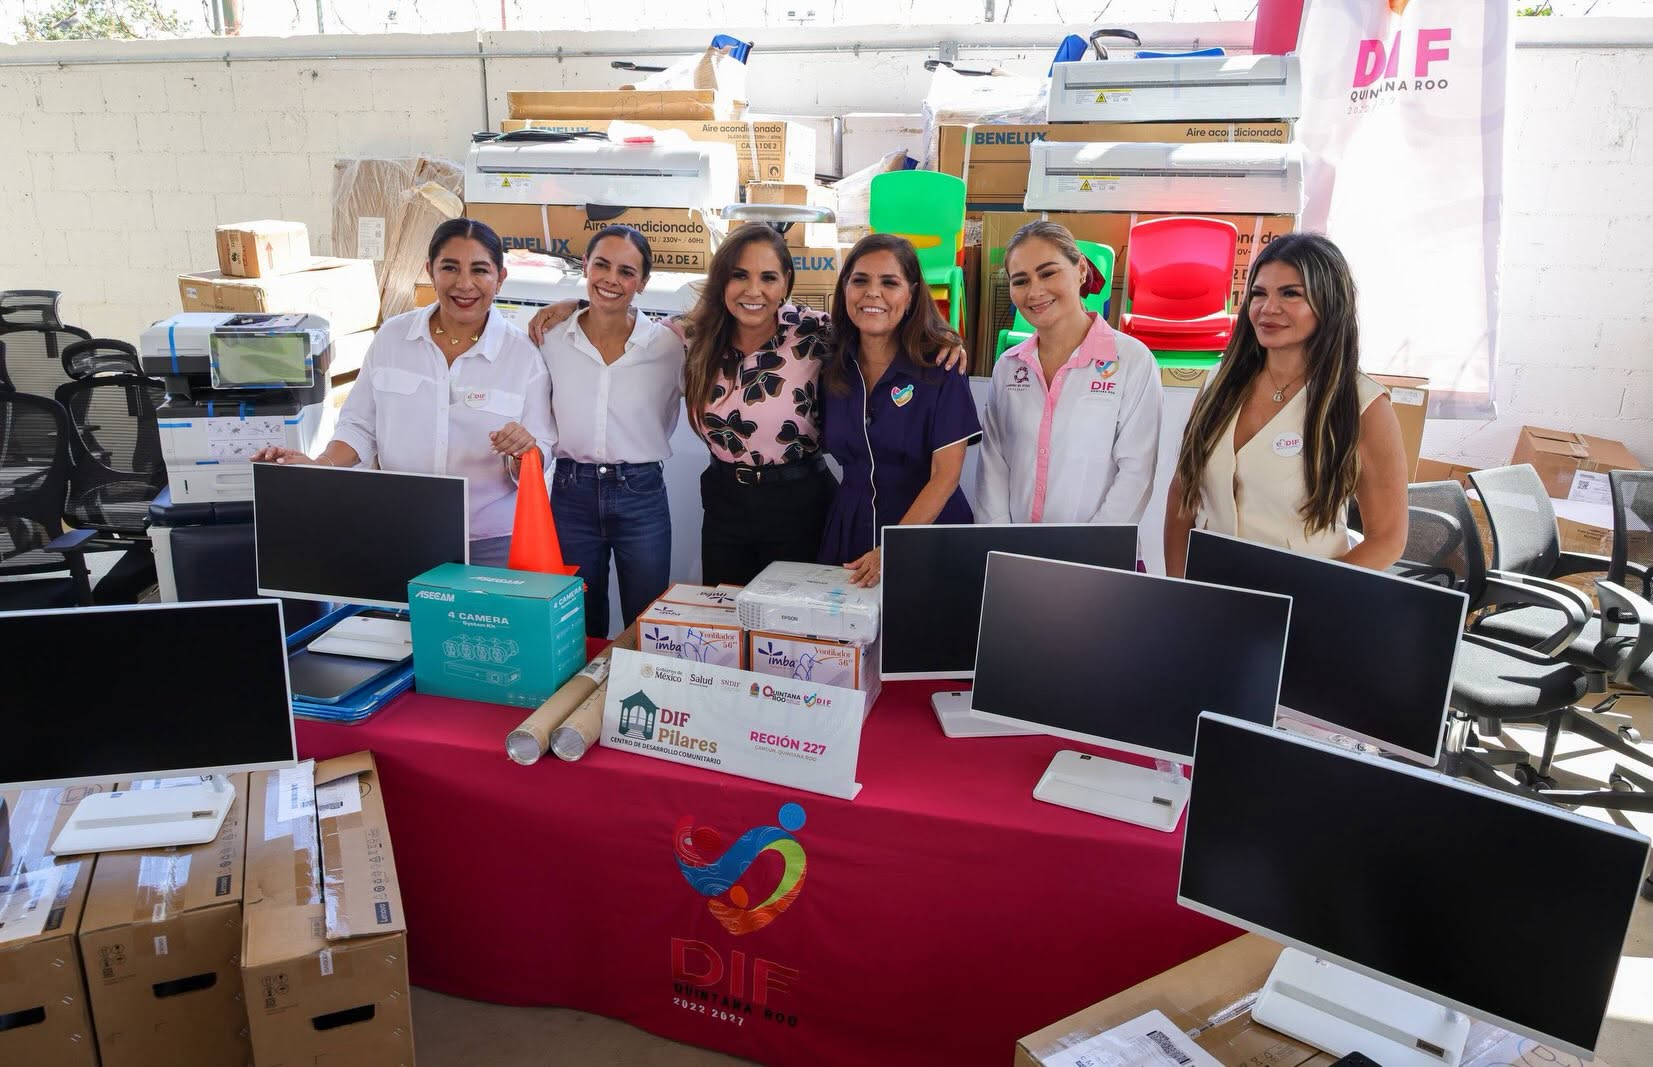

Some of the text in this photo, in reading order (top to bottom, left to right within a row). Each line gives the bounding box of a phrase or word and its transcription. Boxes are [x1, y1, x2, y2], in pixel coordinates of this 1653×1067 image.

[1353, 28, 1452, 88] DIF
[1415, 79, 1448, 91] ROO
[702, 124, 782, 133] Aire acondionado
[1186, 128, 1206, 137] Aire
[975, 132, 1048, 144] BENELUX
[584, 220, 607, 231] Aire
[501, 237, 570, 253] ENELUX
[667, 256, 673, 264] 2
[676, 256, 692, 265] DE
[694, 257, 699, 265] 2
[791, 256, 835, 271] ELUX
[1091, 381, 1117, 391] DIF
[448, 611, 509, 625] 4 CAMERA
[655, 640, 682, 652] imba
[768, 656, 796, 668] imba
[655, 671, 682, 683] México
[689, 673, 713, 685] Salud
[762, 685, 801, 700] QUINTANA
[816, 698, 832, 706] DIF
[660, 708, 690, 727] DIF
[657, 727, 718, 753] Pilares
[750, 731, 826, 755] REGIÓN 227
[610, 736, 632, 746] CENTRO
[642, 743, 679, 756] DESARROLLO
[678, 751, 721, 765] COMUNITARIO
[379, 903, 388, 923] Lenovo
[671, 937, 800, 1005] DIF
[673, 997, 744, 1026] 2022 2027
[674, 982, 797, 1028] QUINTANA ROO
